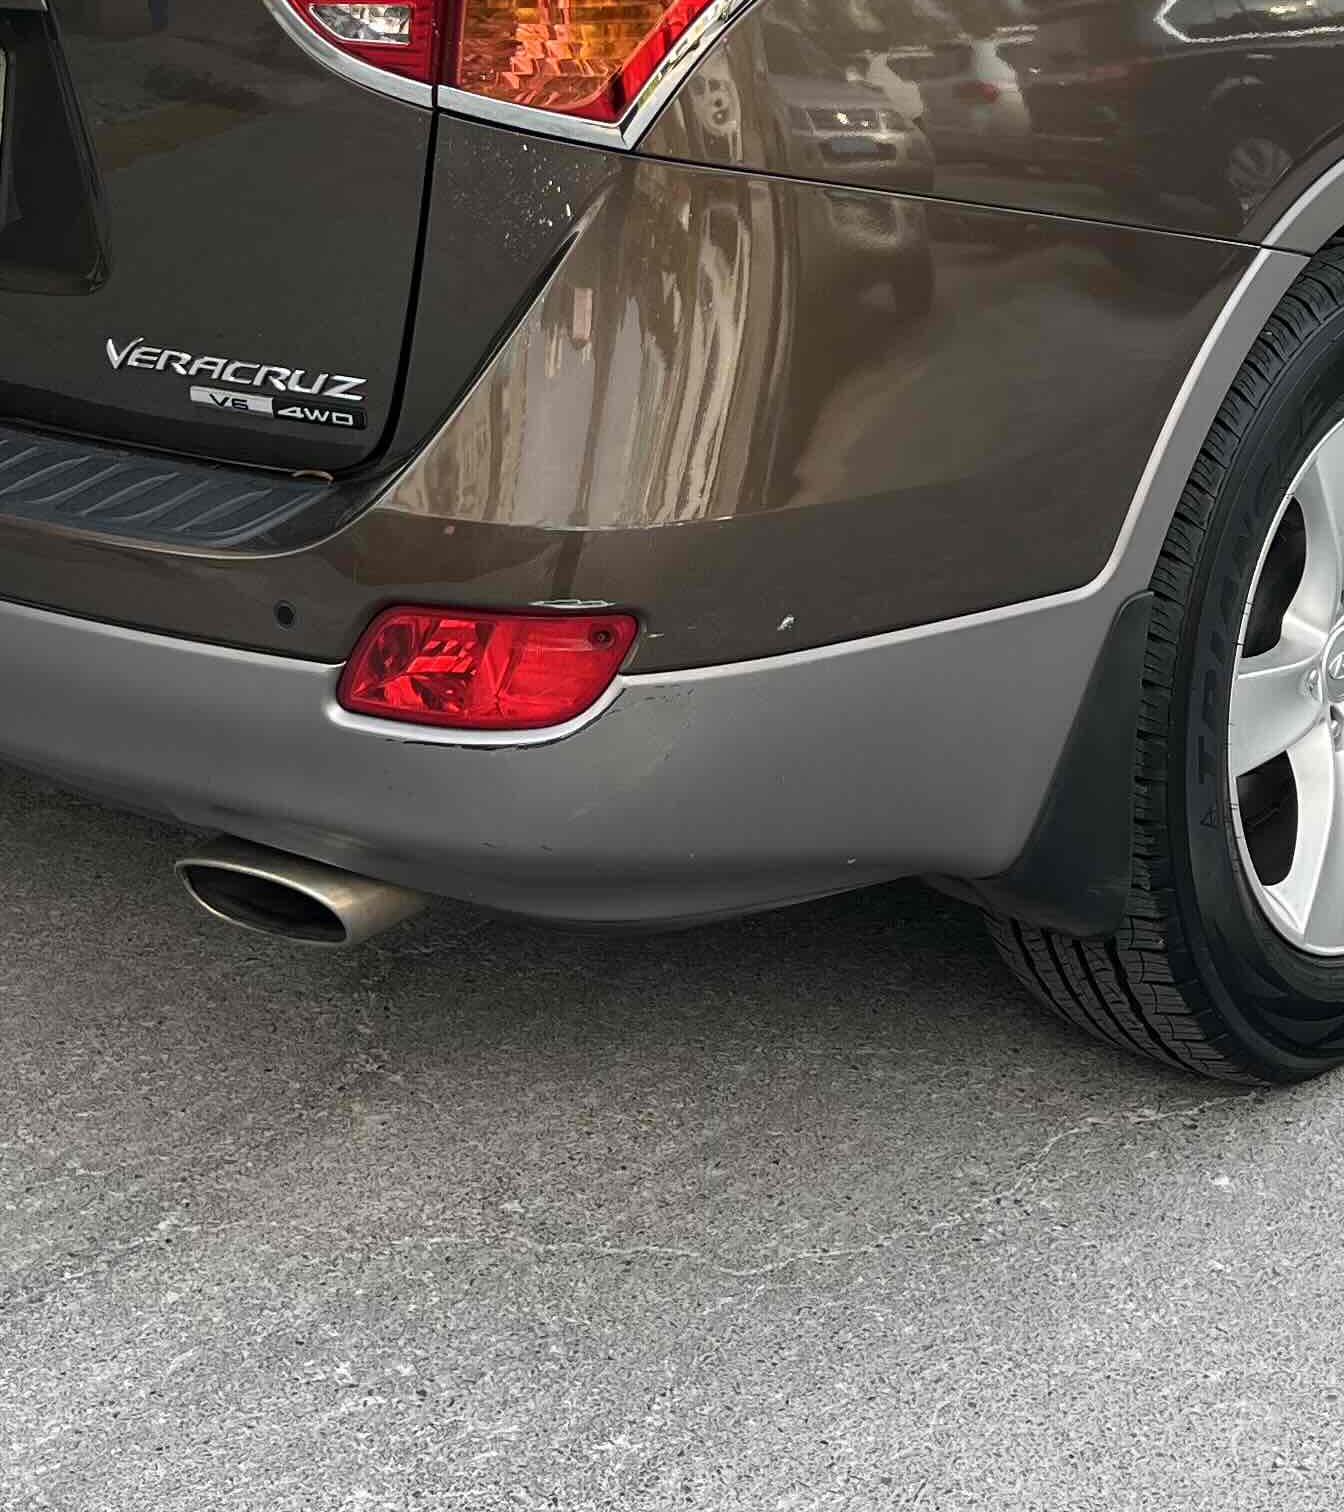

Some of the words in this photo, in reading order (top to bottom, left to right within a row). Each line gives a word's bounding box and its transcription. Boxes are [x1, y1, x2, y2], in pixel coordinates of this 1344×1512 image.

[106, 337, 368, 400] VERACRUZ
[209, 393, 249, 410] V6
[277, 407, 353, 426] 4WD
